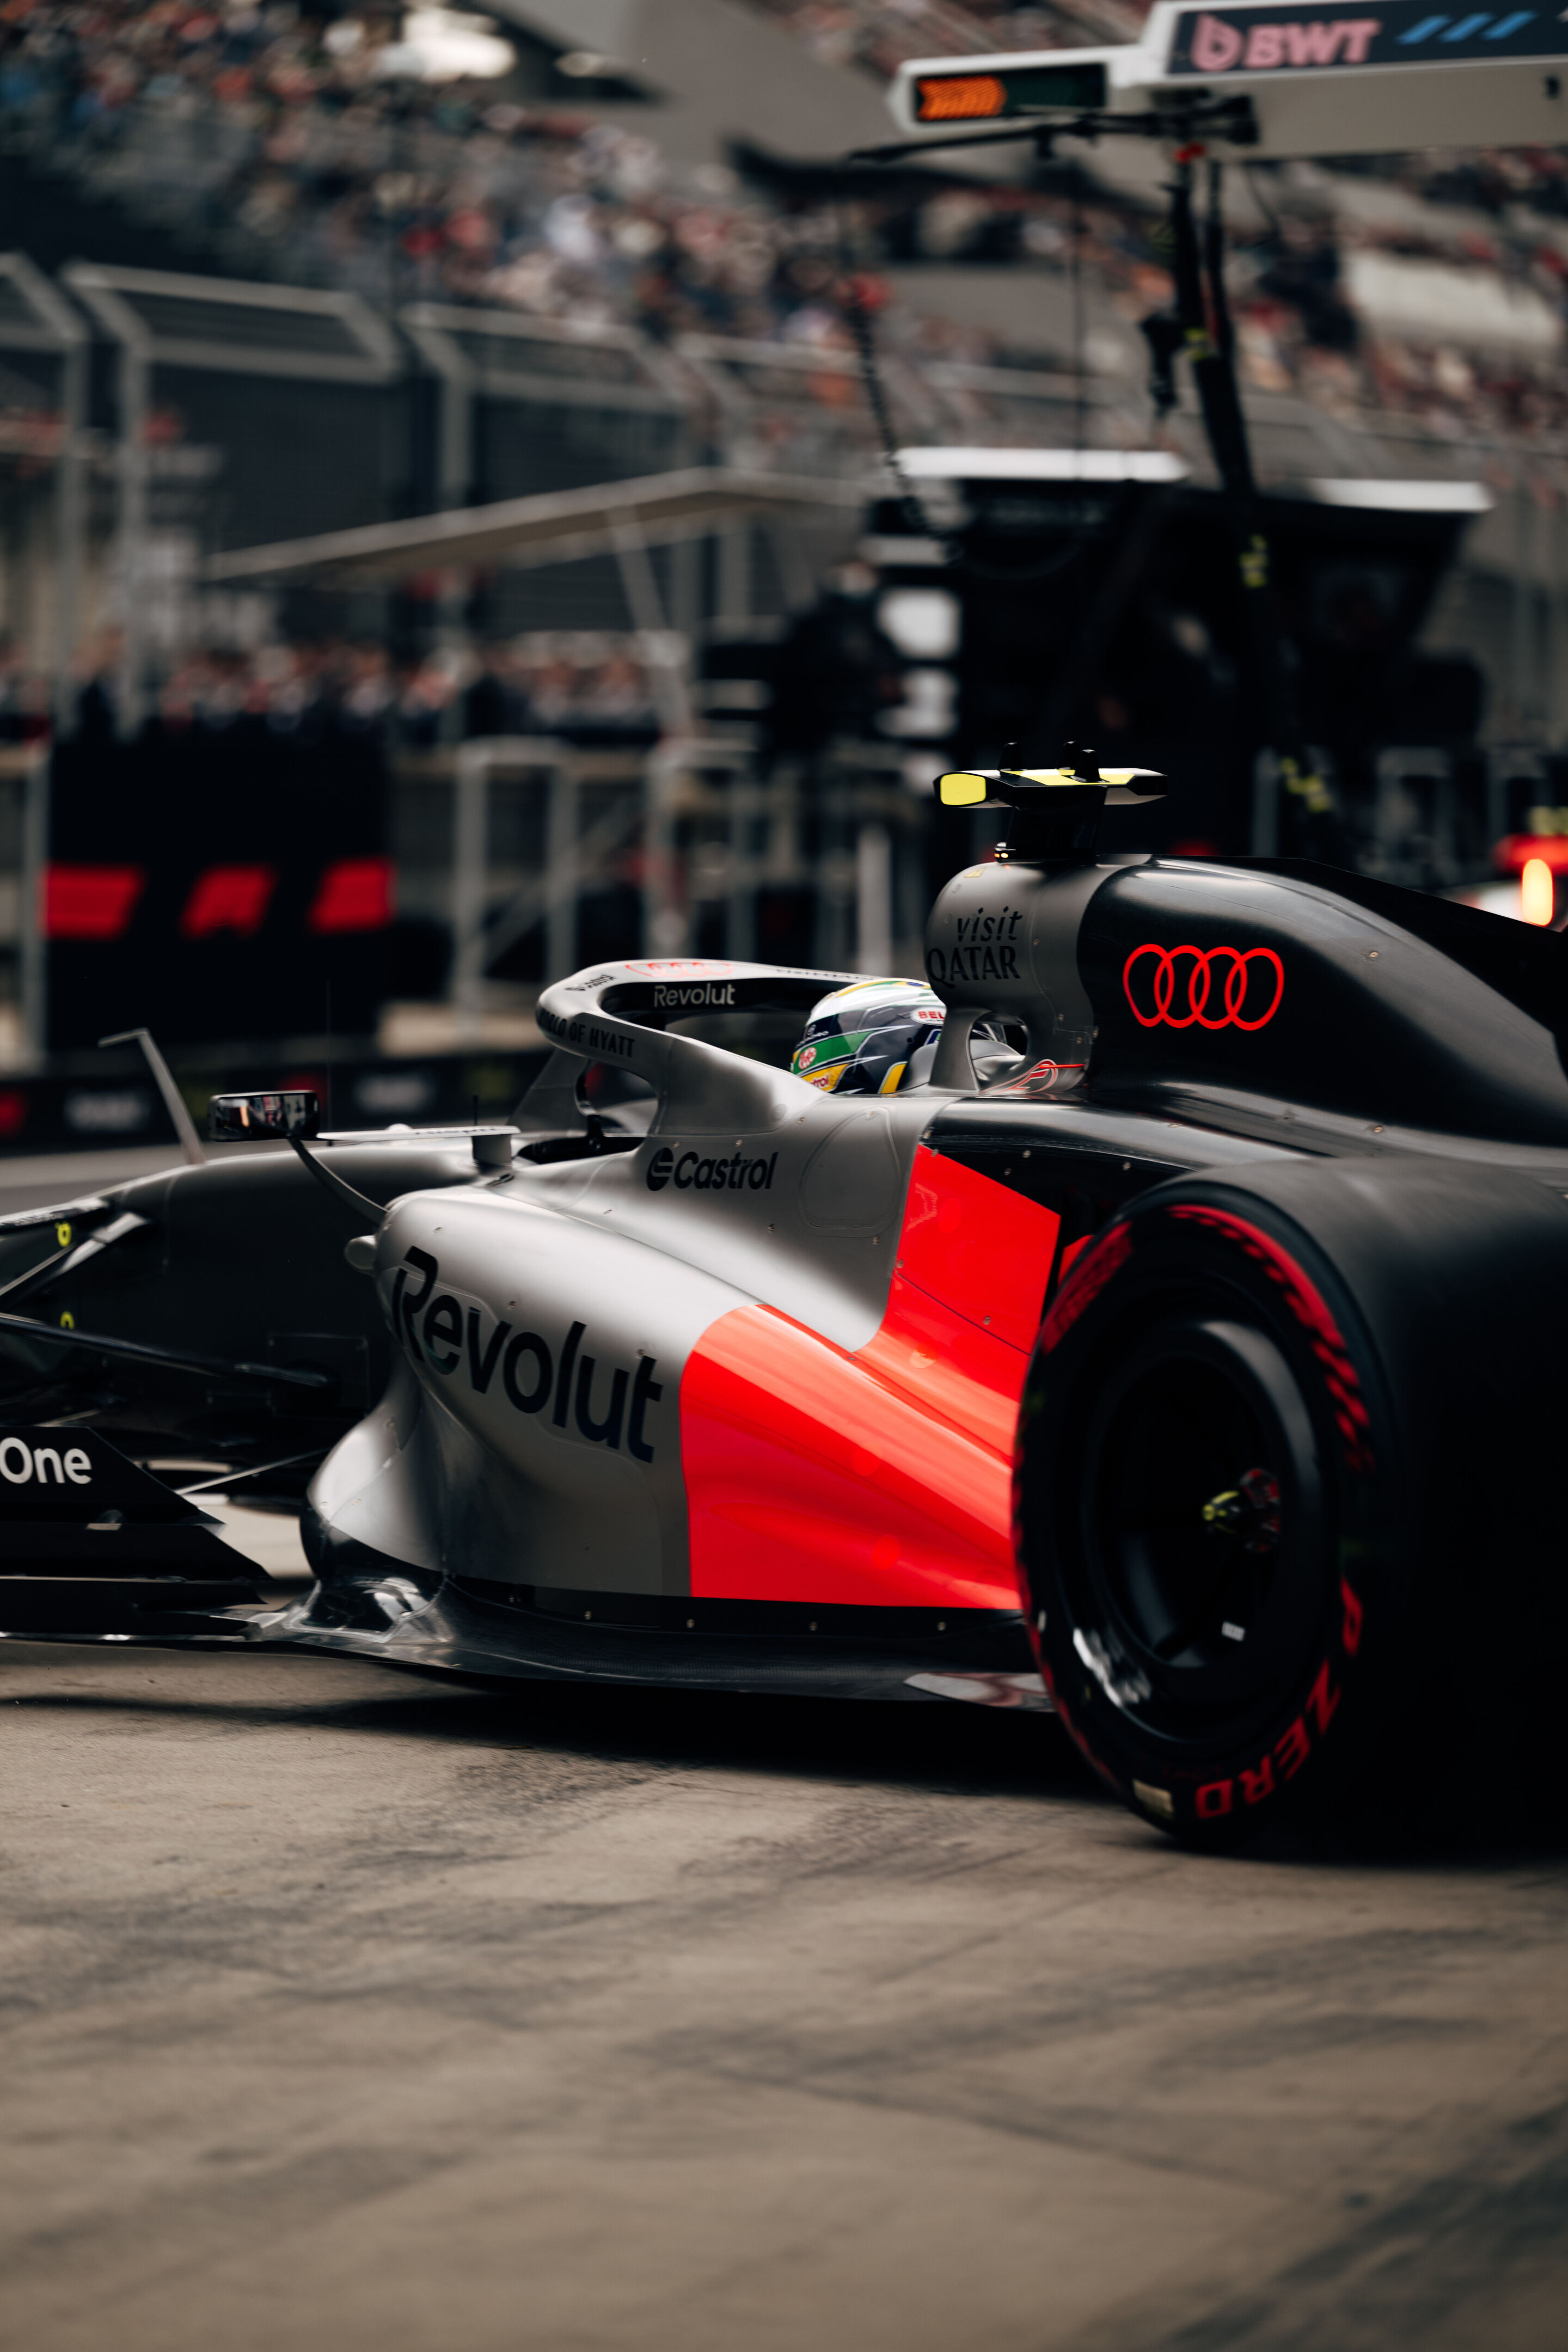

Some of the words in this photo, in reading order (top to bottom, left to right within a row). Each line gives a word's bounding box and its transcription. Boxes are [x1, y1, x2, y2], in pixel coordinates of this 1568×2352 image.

[1243, 17, 1382, 68] BWT
[957, 906, 1023, 942] visit
[927, 946, 1021, 989] QATAR
[654, 983, 736, 1008] Revolut
[917, 1011, 945, 1020] BEL
[569, 1022, 586, 1043] OF
[590, 1027, 635, 1058] HYATT
[810, 1073, 829, 1087] trol
[674, 1152, 779, 1189] Castrol
[391, 1246, 663, 1463] Revolut
[0, 1436, 93, 1485] One
[1194, 1657, 1342, 1820] ZERO
